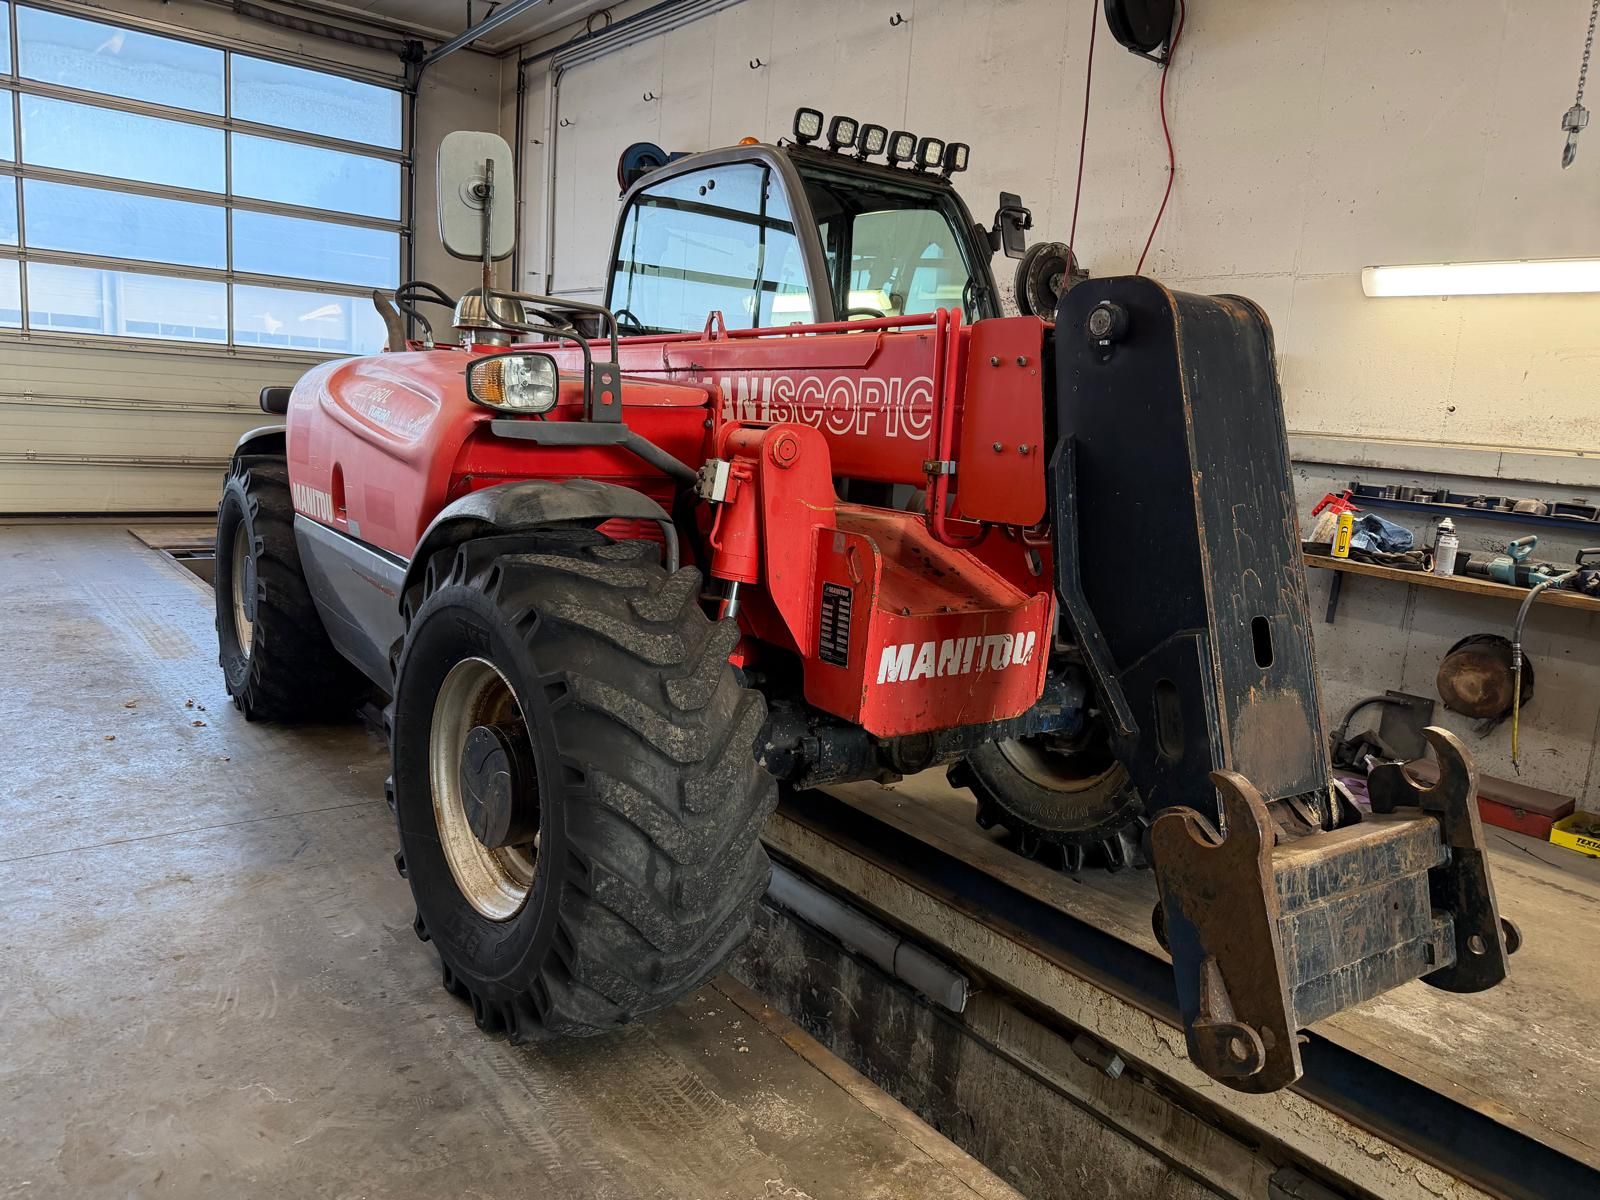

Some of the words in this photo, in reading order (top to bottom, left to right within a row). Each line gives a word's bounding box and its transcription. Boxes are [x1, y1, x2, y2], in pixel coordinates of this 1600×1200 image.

[688, 376, 934, 440] ANISCOPIC
[292, 482, 334, 523] MANITOU
[876, 631, 1036, 685] MANITOU
